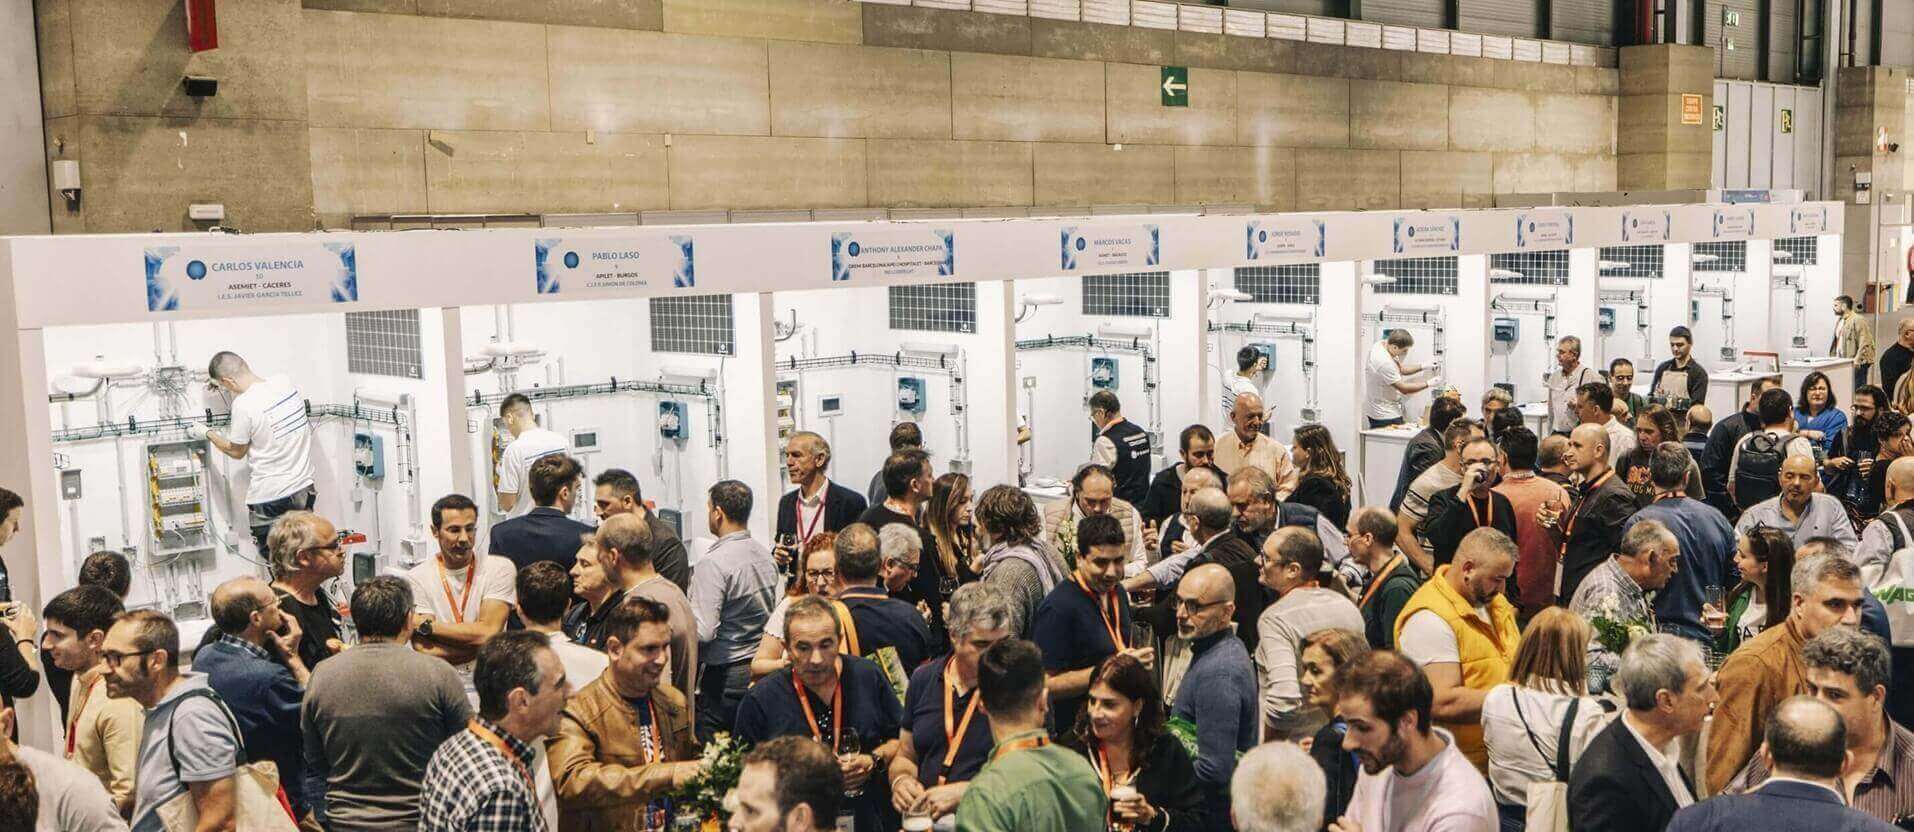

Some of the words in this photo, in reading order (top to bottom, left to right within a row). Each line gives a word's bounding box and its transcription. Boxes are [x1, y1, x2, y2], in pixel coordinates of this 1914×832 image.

[890, 246, 923, 254] ALEXANDER
[592, 252, 617, 260] PABLO
[619, 251, 640, 259] LASO
[212, 262, 253, 272] CARLOS
[254, 260, 304, 270] VALENCIA
